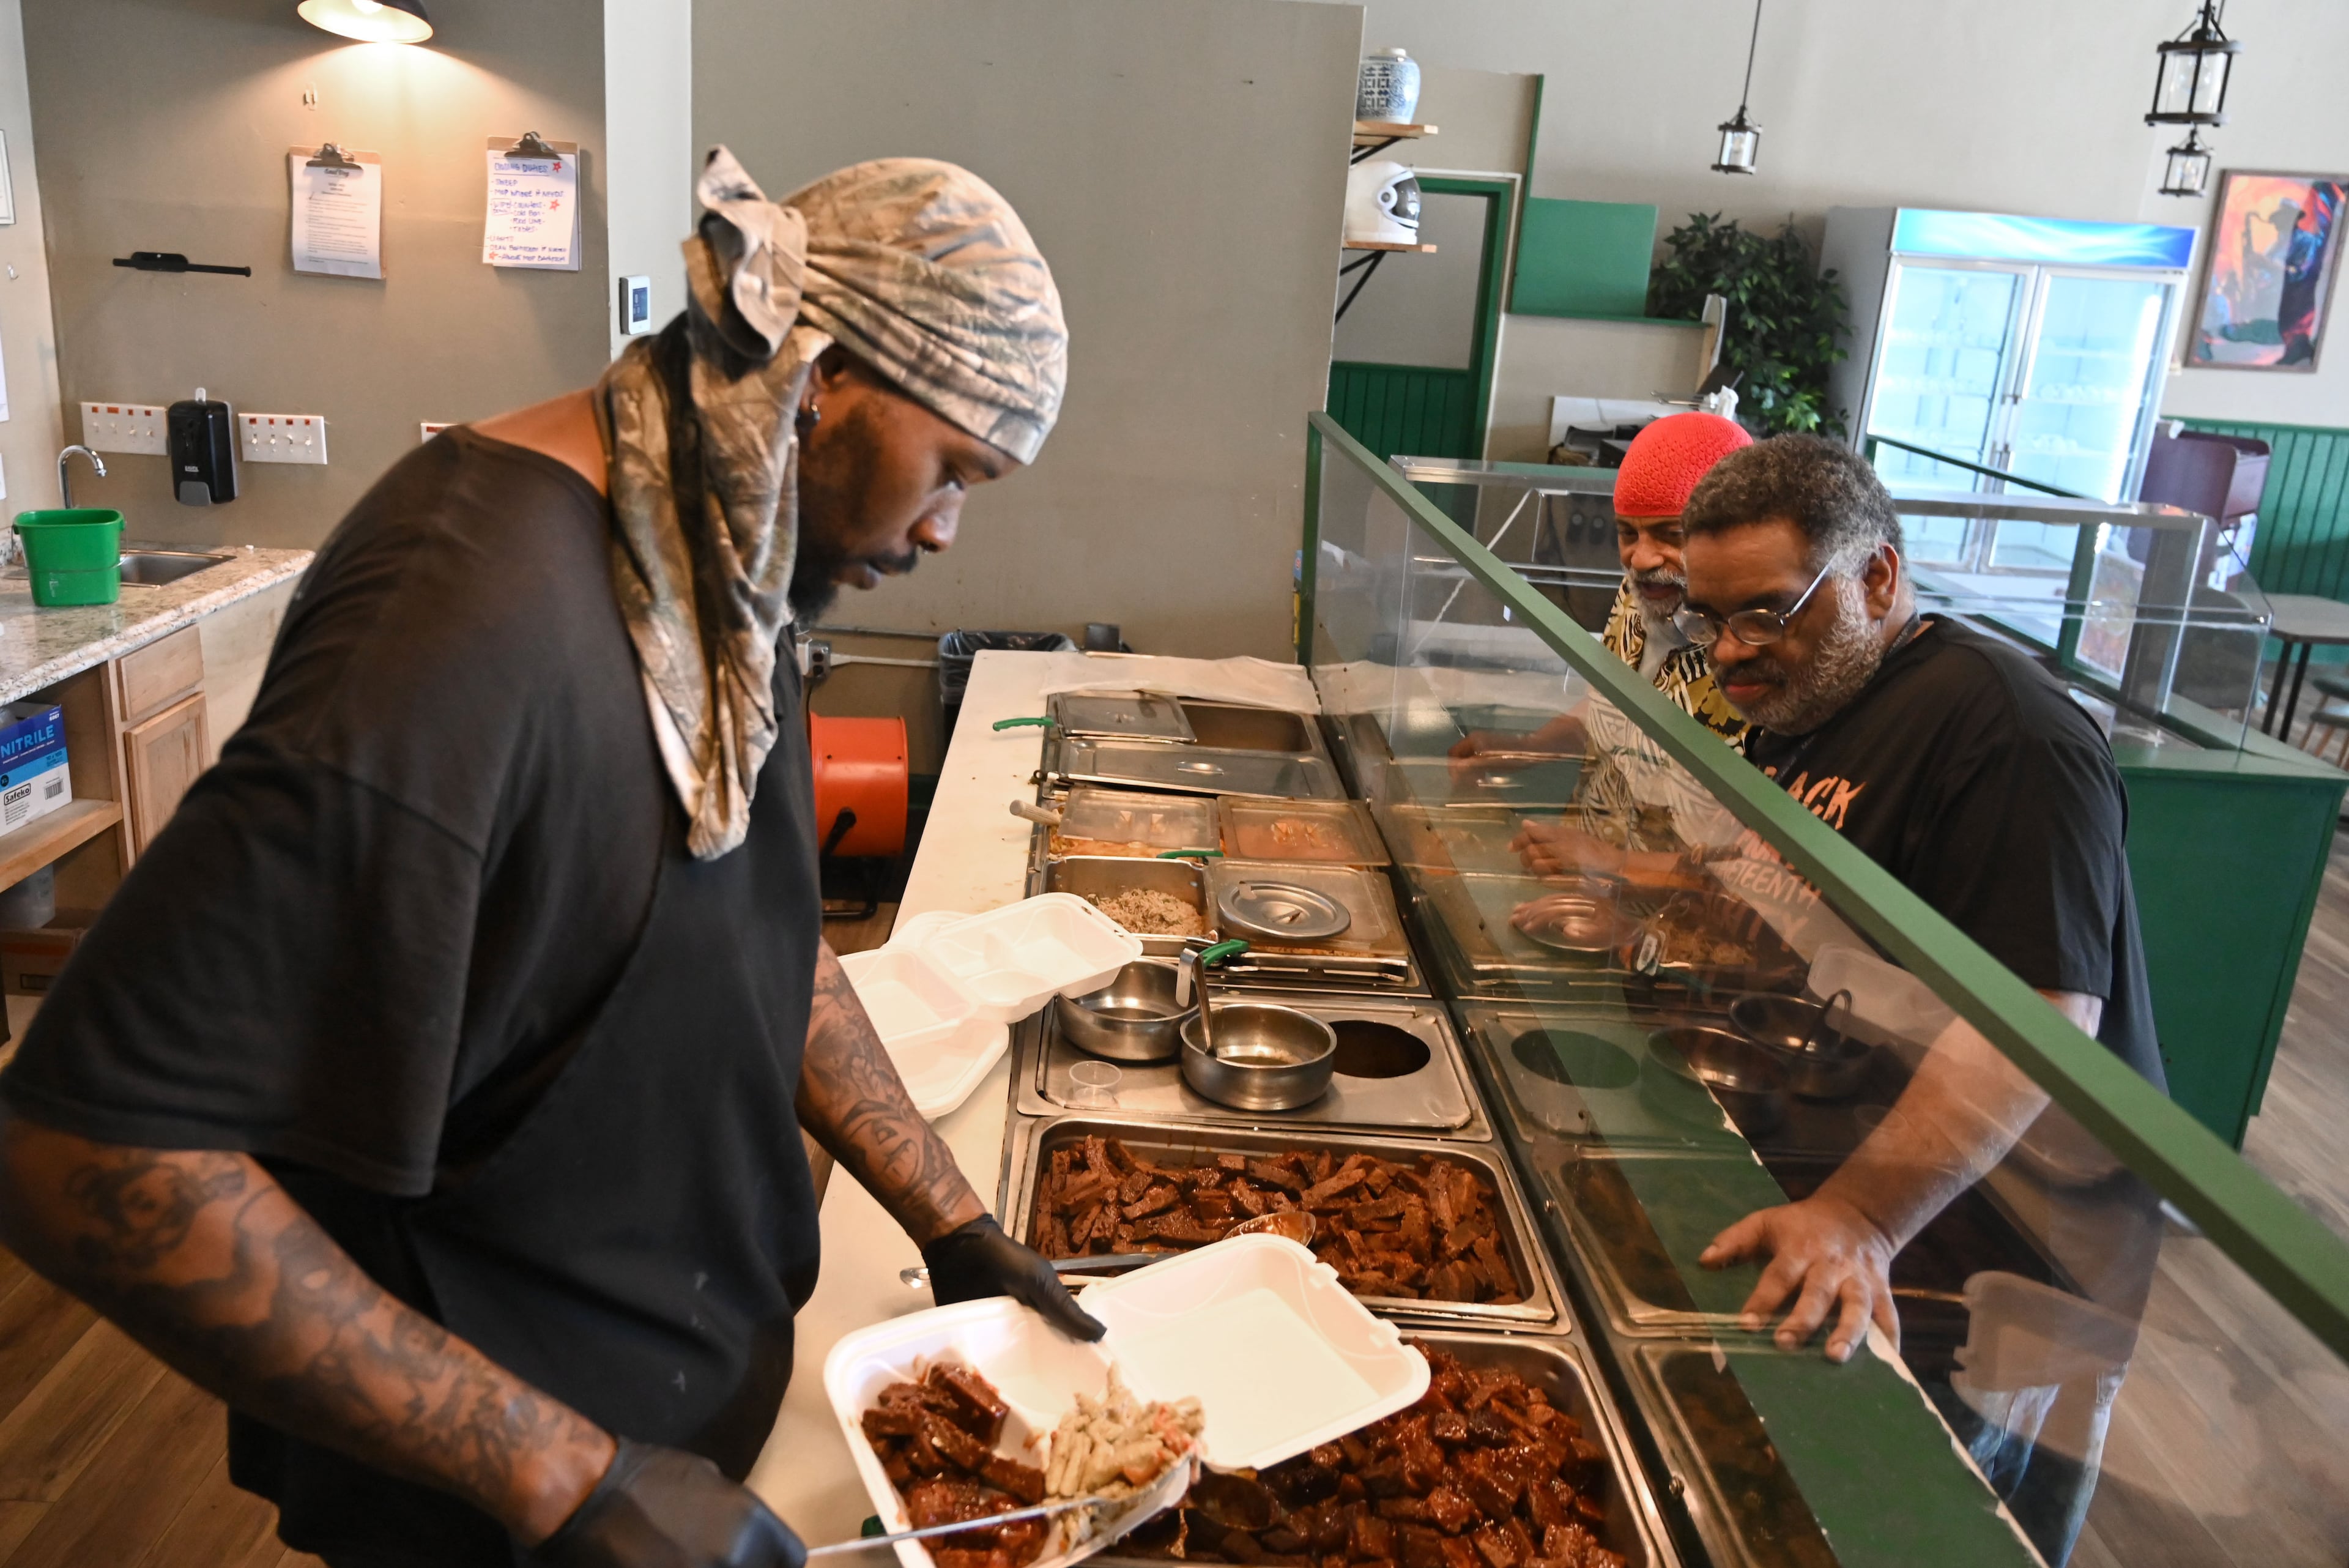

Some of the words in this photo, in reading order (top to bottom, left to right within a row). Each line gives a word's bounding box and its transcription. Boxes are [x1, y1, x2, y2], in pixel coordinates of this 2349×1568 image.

[0, 724, 54, 759] NITRILE
[6, 787, 29, 803] Safeko
[1764, 766, 1866, 830] ACK
